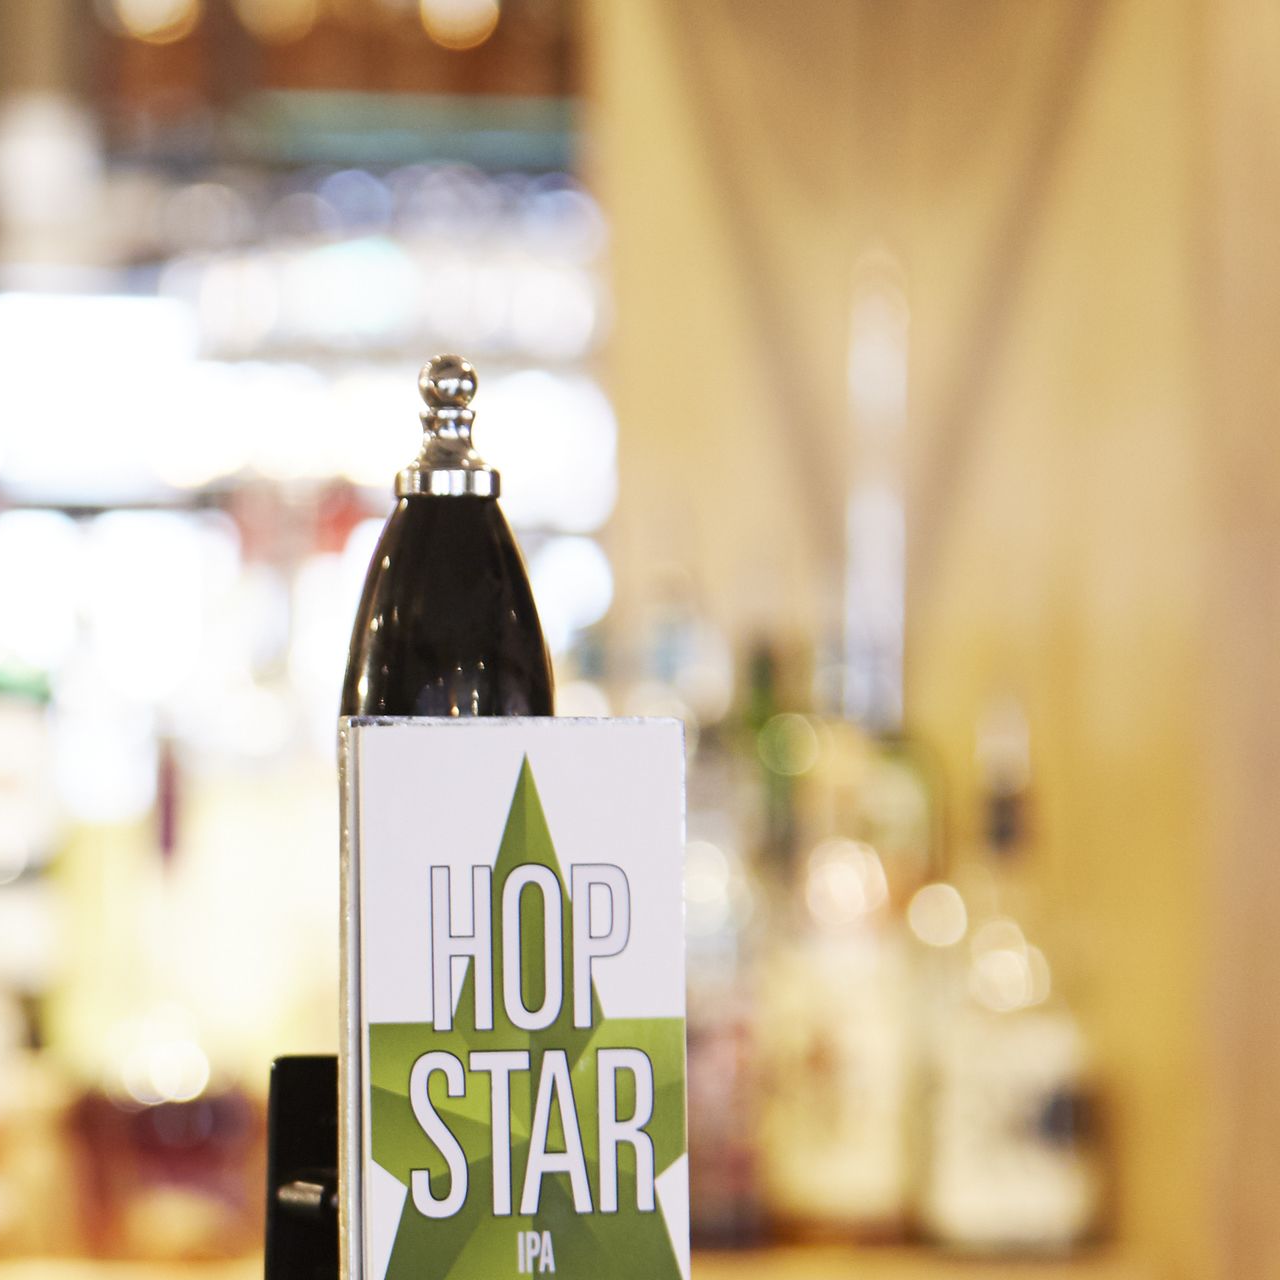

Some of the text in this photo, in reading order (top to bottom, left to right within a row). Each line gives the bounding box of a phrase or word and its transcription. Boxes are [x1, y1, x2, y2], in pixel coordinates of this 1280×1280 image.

[429, 862, 632, 1033] HOP
[407, 1046, 656, 1219] STAR
[517, 1230, 556, 1274] IPA
